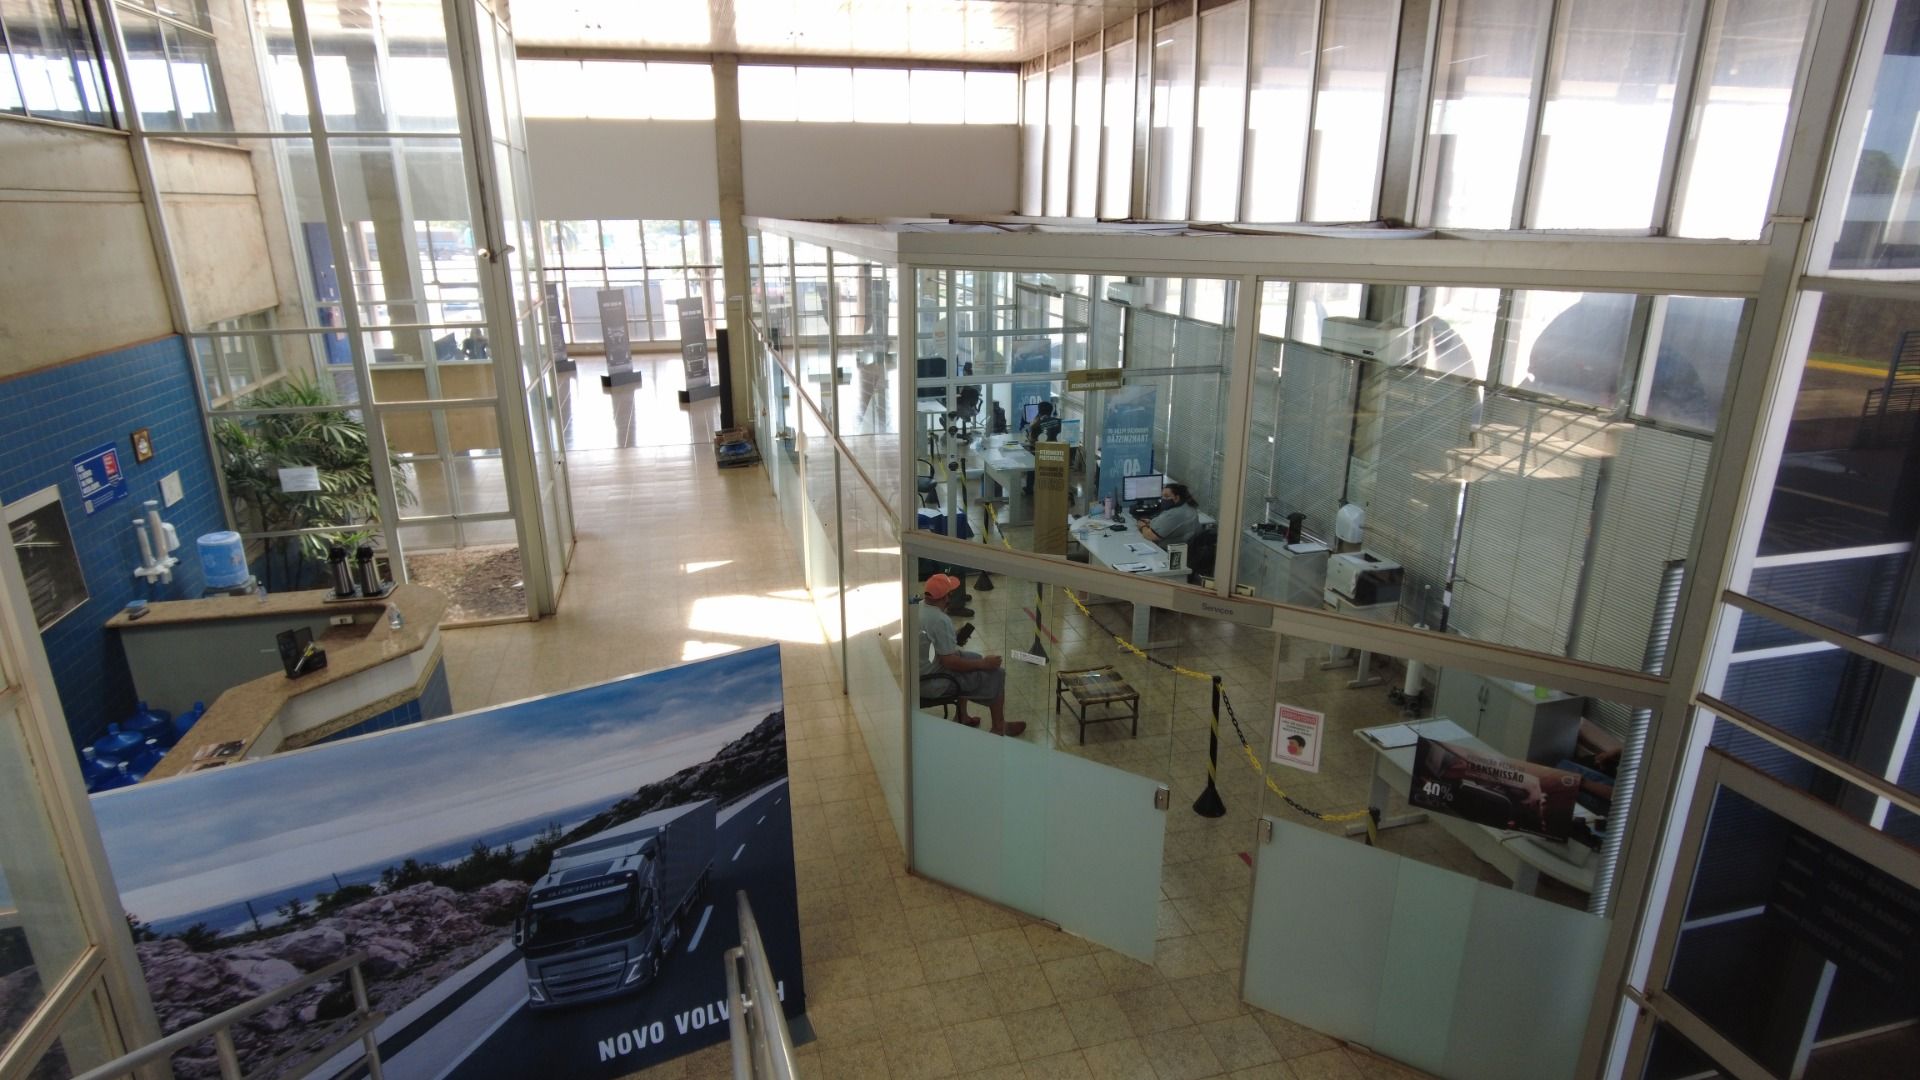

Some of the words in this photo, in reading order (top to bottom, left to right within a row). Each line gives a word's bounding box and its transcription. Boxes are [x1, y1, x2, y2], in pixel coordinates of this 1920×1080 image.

[1466, 761, 1525, 783] TRANSMISSÃO
[598, 1021, 665, 1062] NOVO
[674, 994, 748, 1035] VOLV
